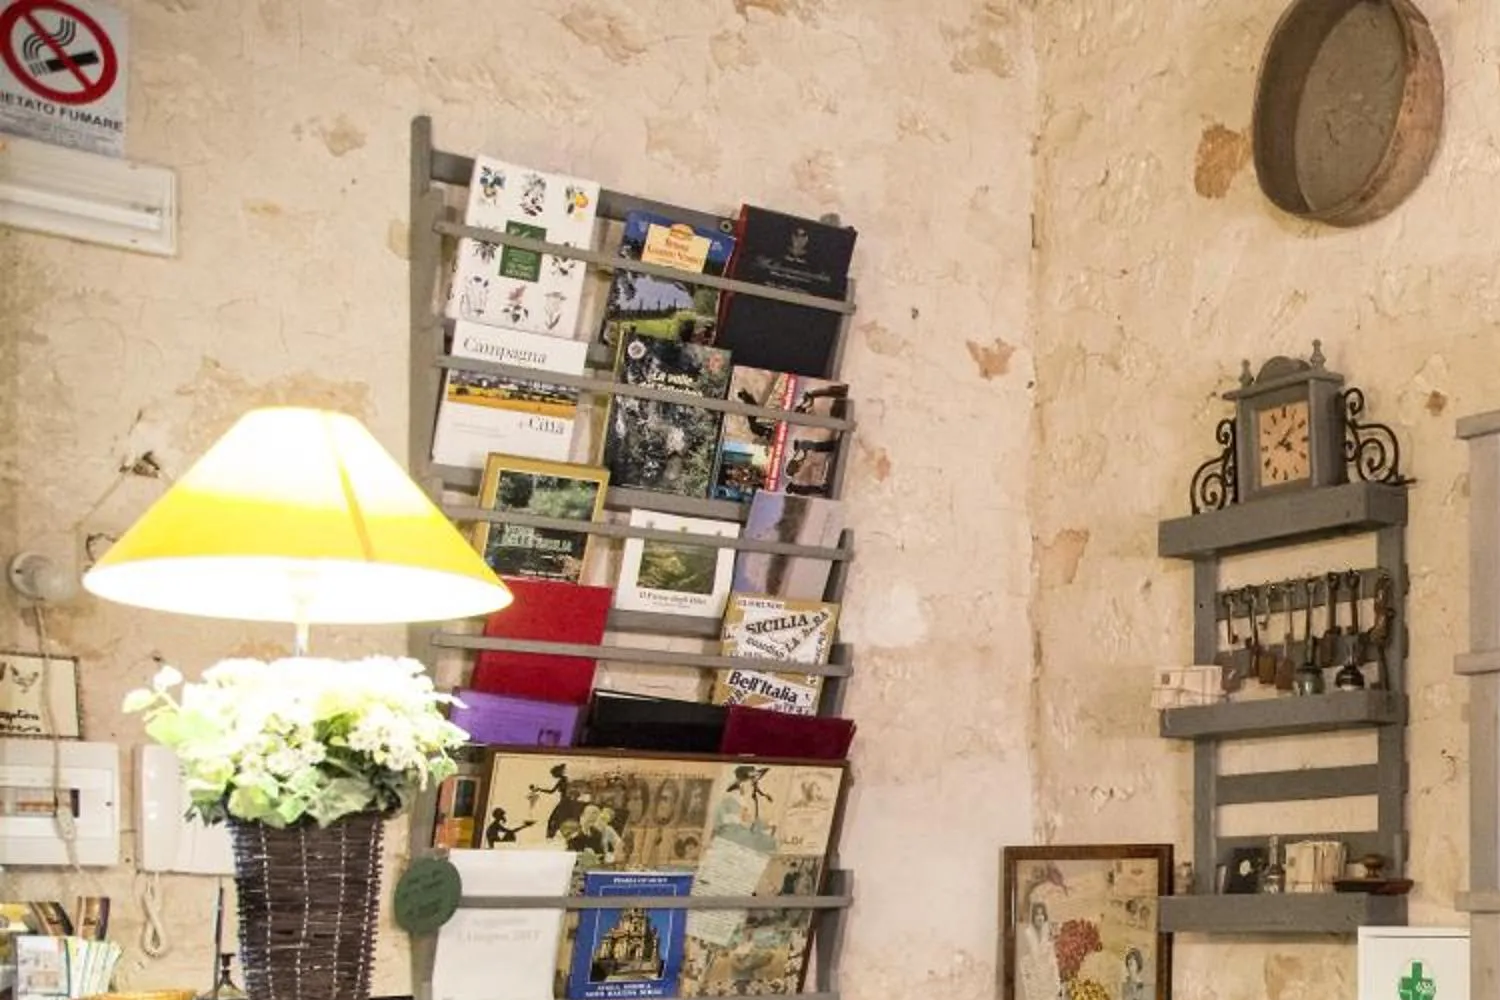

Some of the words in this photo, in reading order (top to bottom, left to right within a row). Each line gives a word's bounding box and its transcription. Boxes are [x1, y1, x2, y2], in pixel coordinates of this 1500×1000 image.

[0, 91, 56, 115] IETATO
[59, 108, 123, 131] FUMARE
[463, 337, 548, 365] Campagna
[745, 613, 808, 635] SICILIA
[728, 671, 797, 703] Bell'Italia
